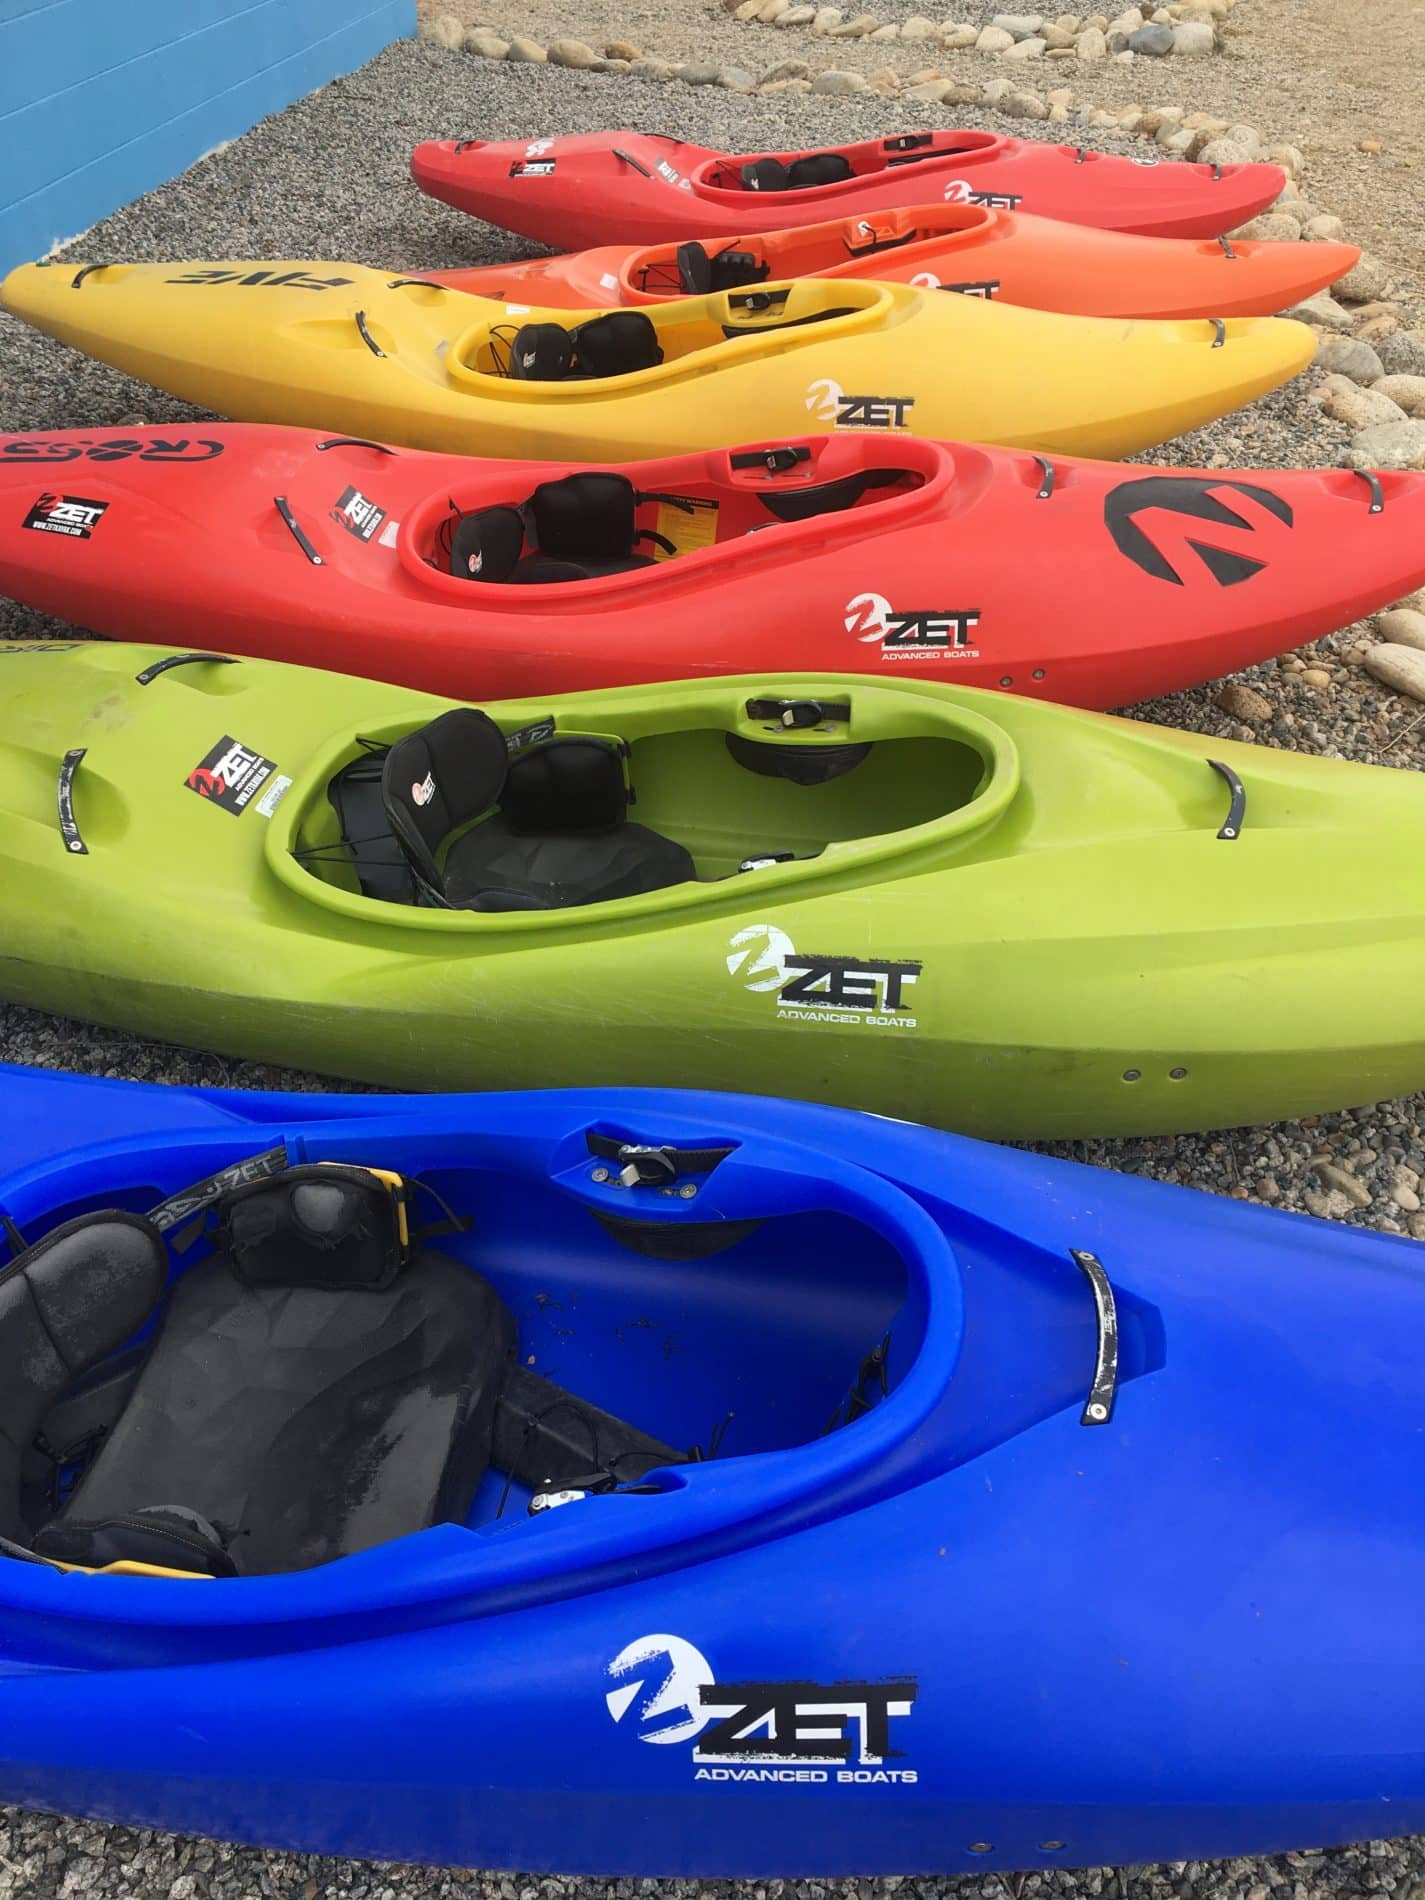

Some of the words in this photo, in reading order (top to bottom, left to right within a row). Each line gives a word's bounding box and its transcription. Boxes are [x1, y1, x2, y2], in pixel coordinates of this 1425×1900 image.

[834, 395, 915, 429] ZET
[48, 501, 105, 525] ZET
[343, 491, 374, 525] ZET
[881, 608, 981, 651] ZET
[881, 651, 940, 661] ADVANCED
[944, 650, 979, 658] BOATS
[209, 742, 259, 788] ZET
[777, 953, 923, 1013] ZET
[776, 1009, 861, 1024] ADVANCED
[866, 1015, 917, 1028] BOATS
[223, 1154, 274, 1191] ZET
[694, 1675, 918, 1764] ZET
[694, 1768, 828, 1783] ADVANCED
[836, 1770, 919, 1784] BOATS
